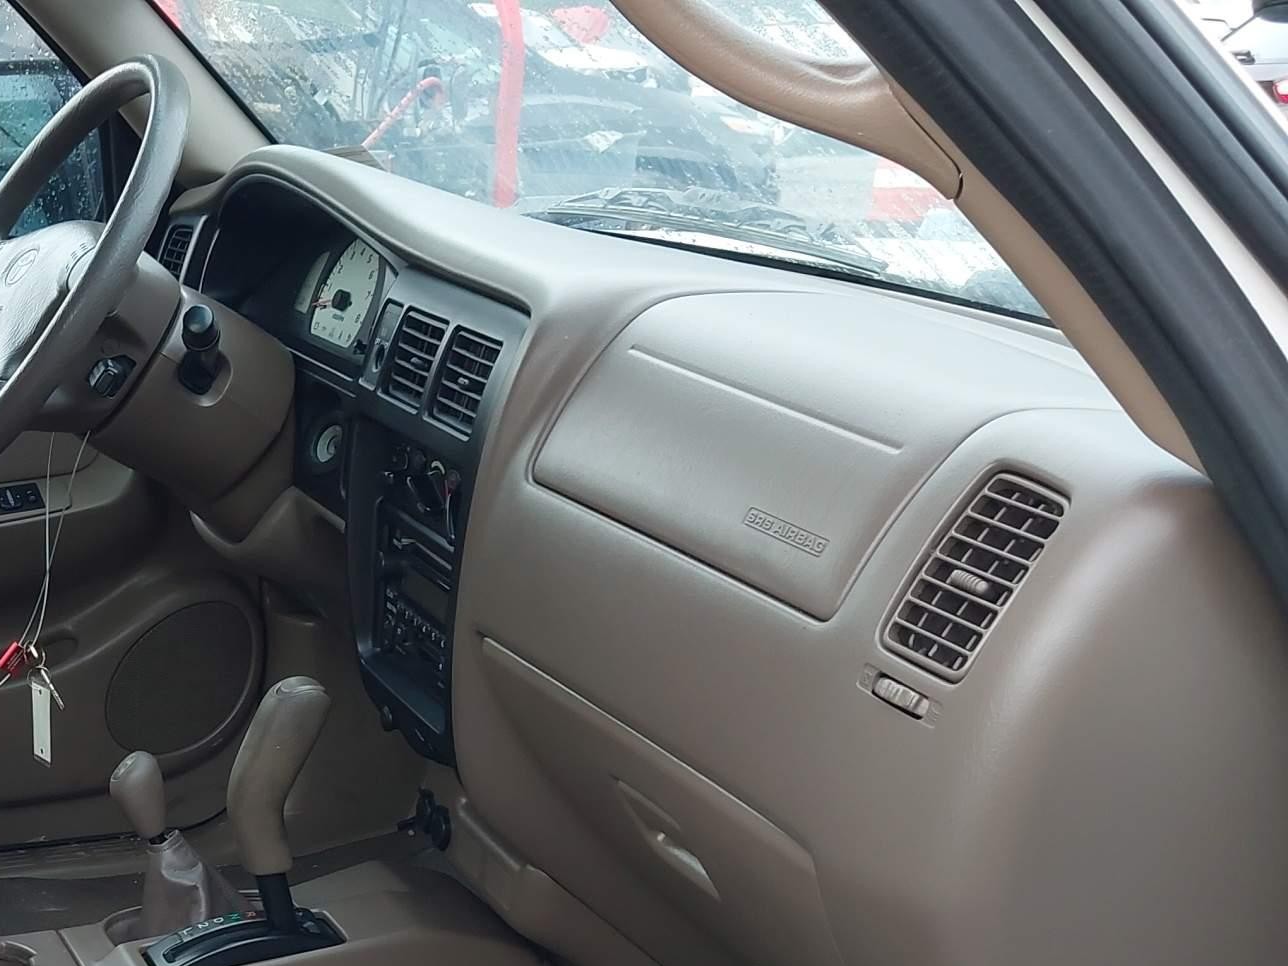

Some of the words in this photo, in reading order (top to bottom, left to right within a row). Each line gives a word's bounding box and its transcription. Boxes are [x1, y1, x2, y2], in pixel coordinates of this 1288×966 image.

[747, 510, 772, 531] SRS
[772, 524, 825, 552] AIRBAG
[183, 927, 193, 935] L
